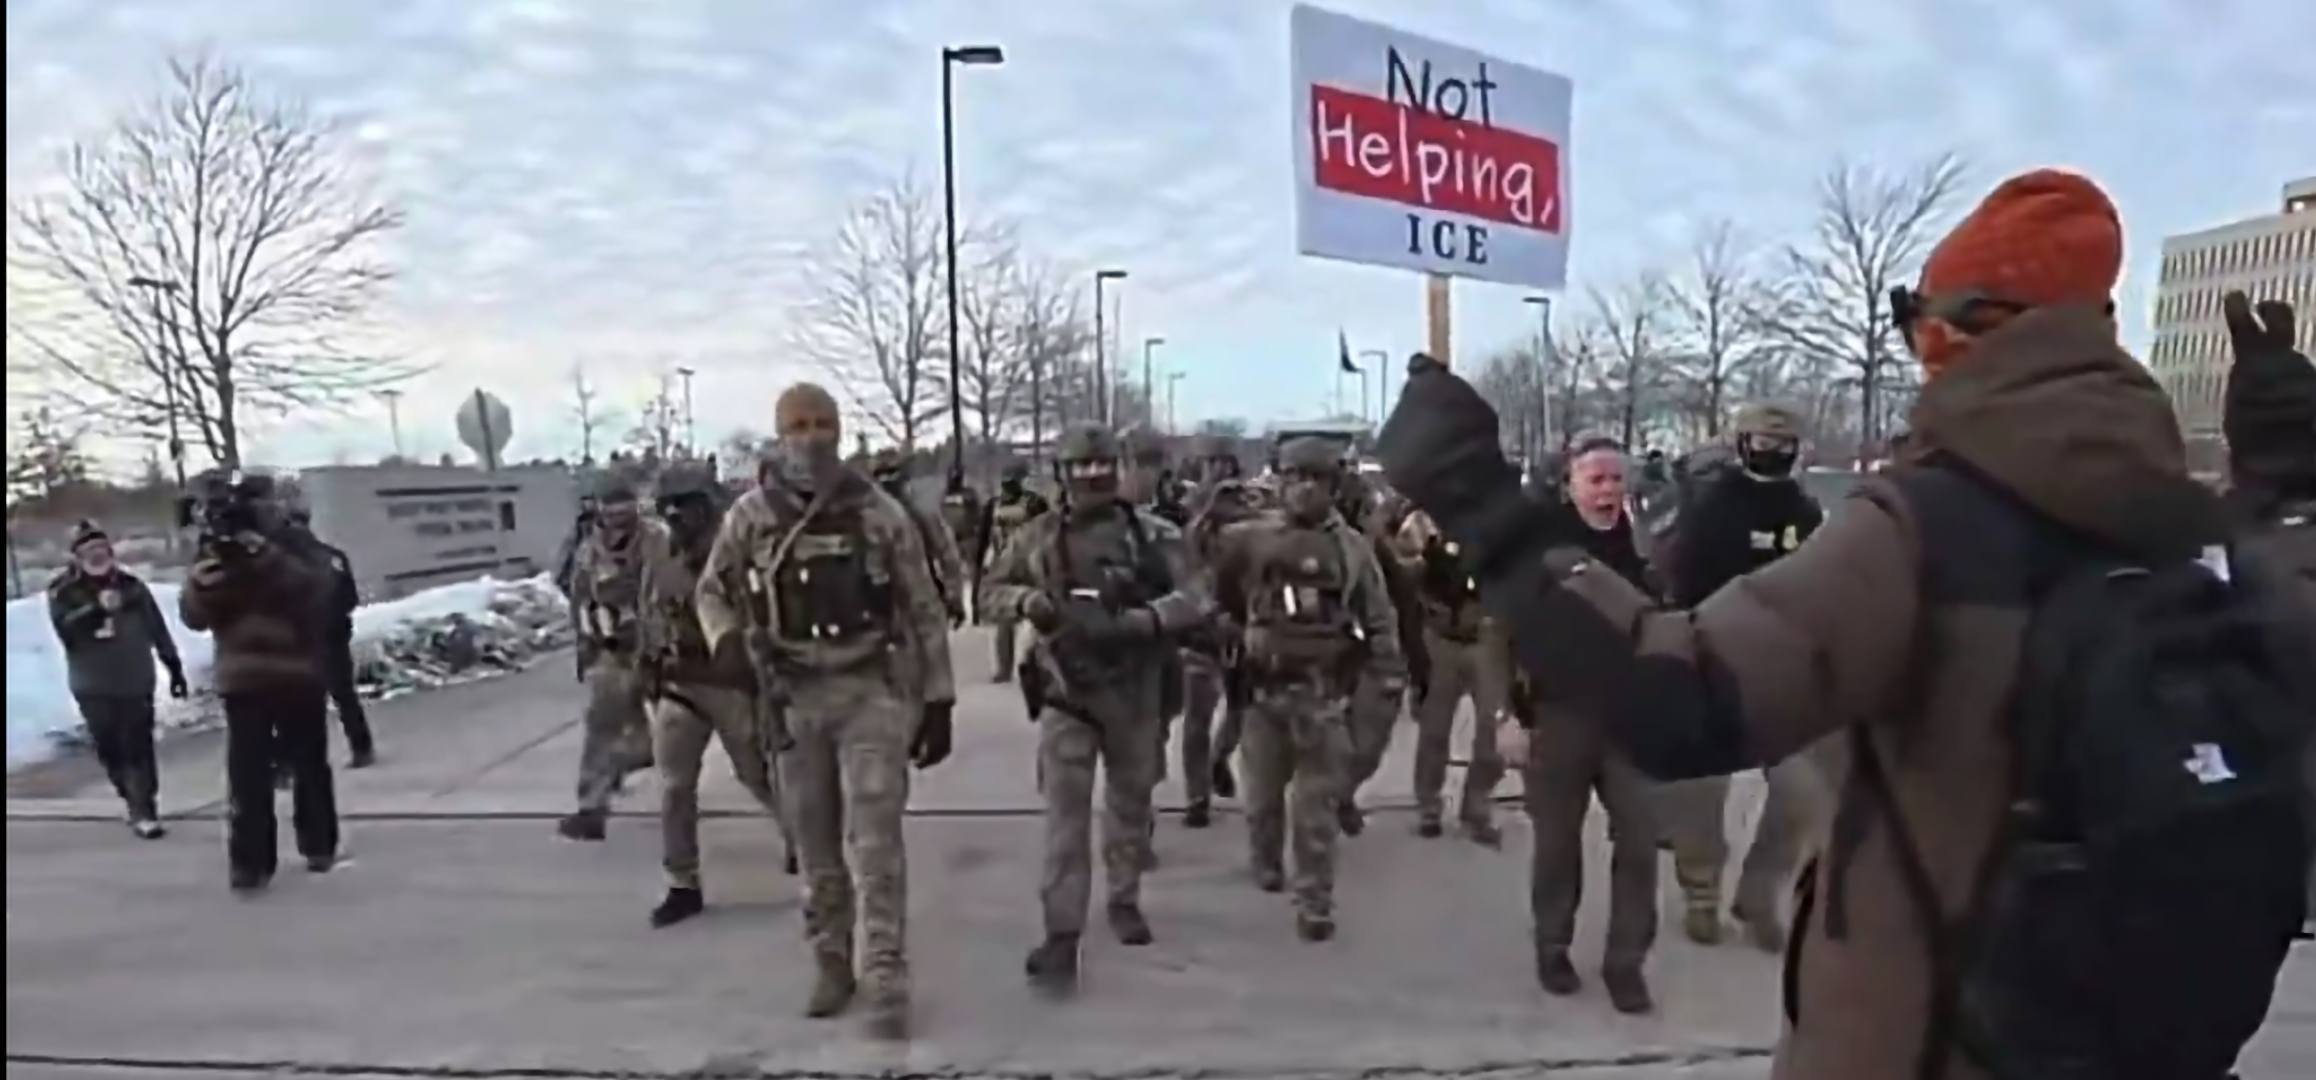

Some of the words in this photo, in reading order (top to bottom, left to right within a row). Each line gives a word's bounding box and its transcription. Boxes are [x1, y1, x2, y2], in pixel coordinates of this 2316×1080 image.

[1387, 44, 1497, 130] Not
[1317, 100, 1553, 223] Helping,
[1406, 212, 1489, 265] ICE
